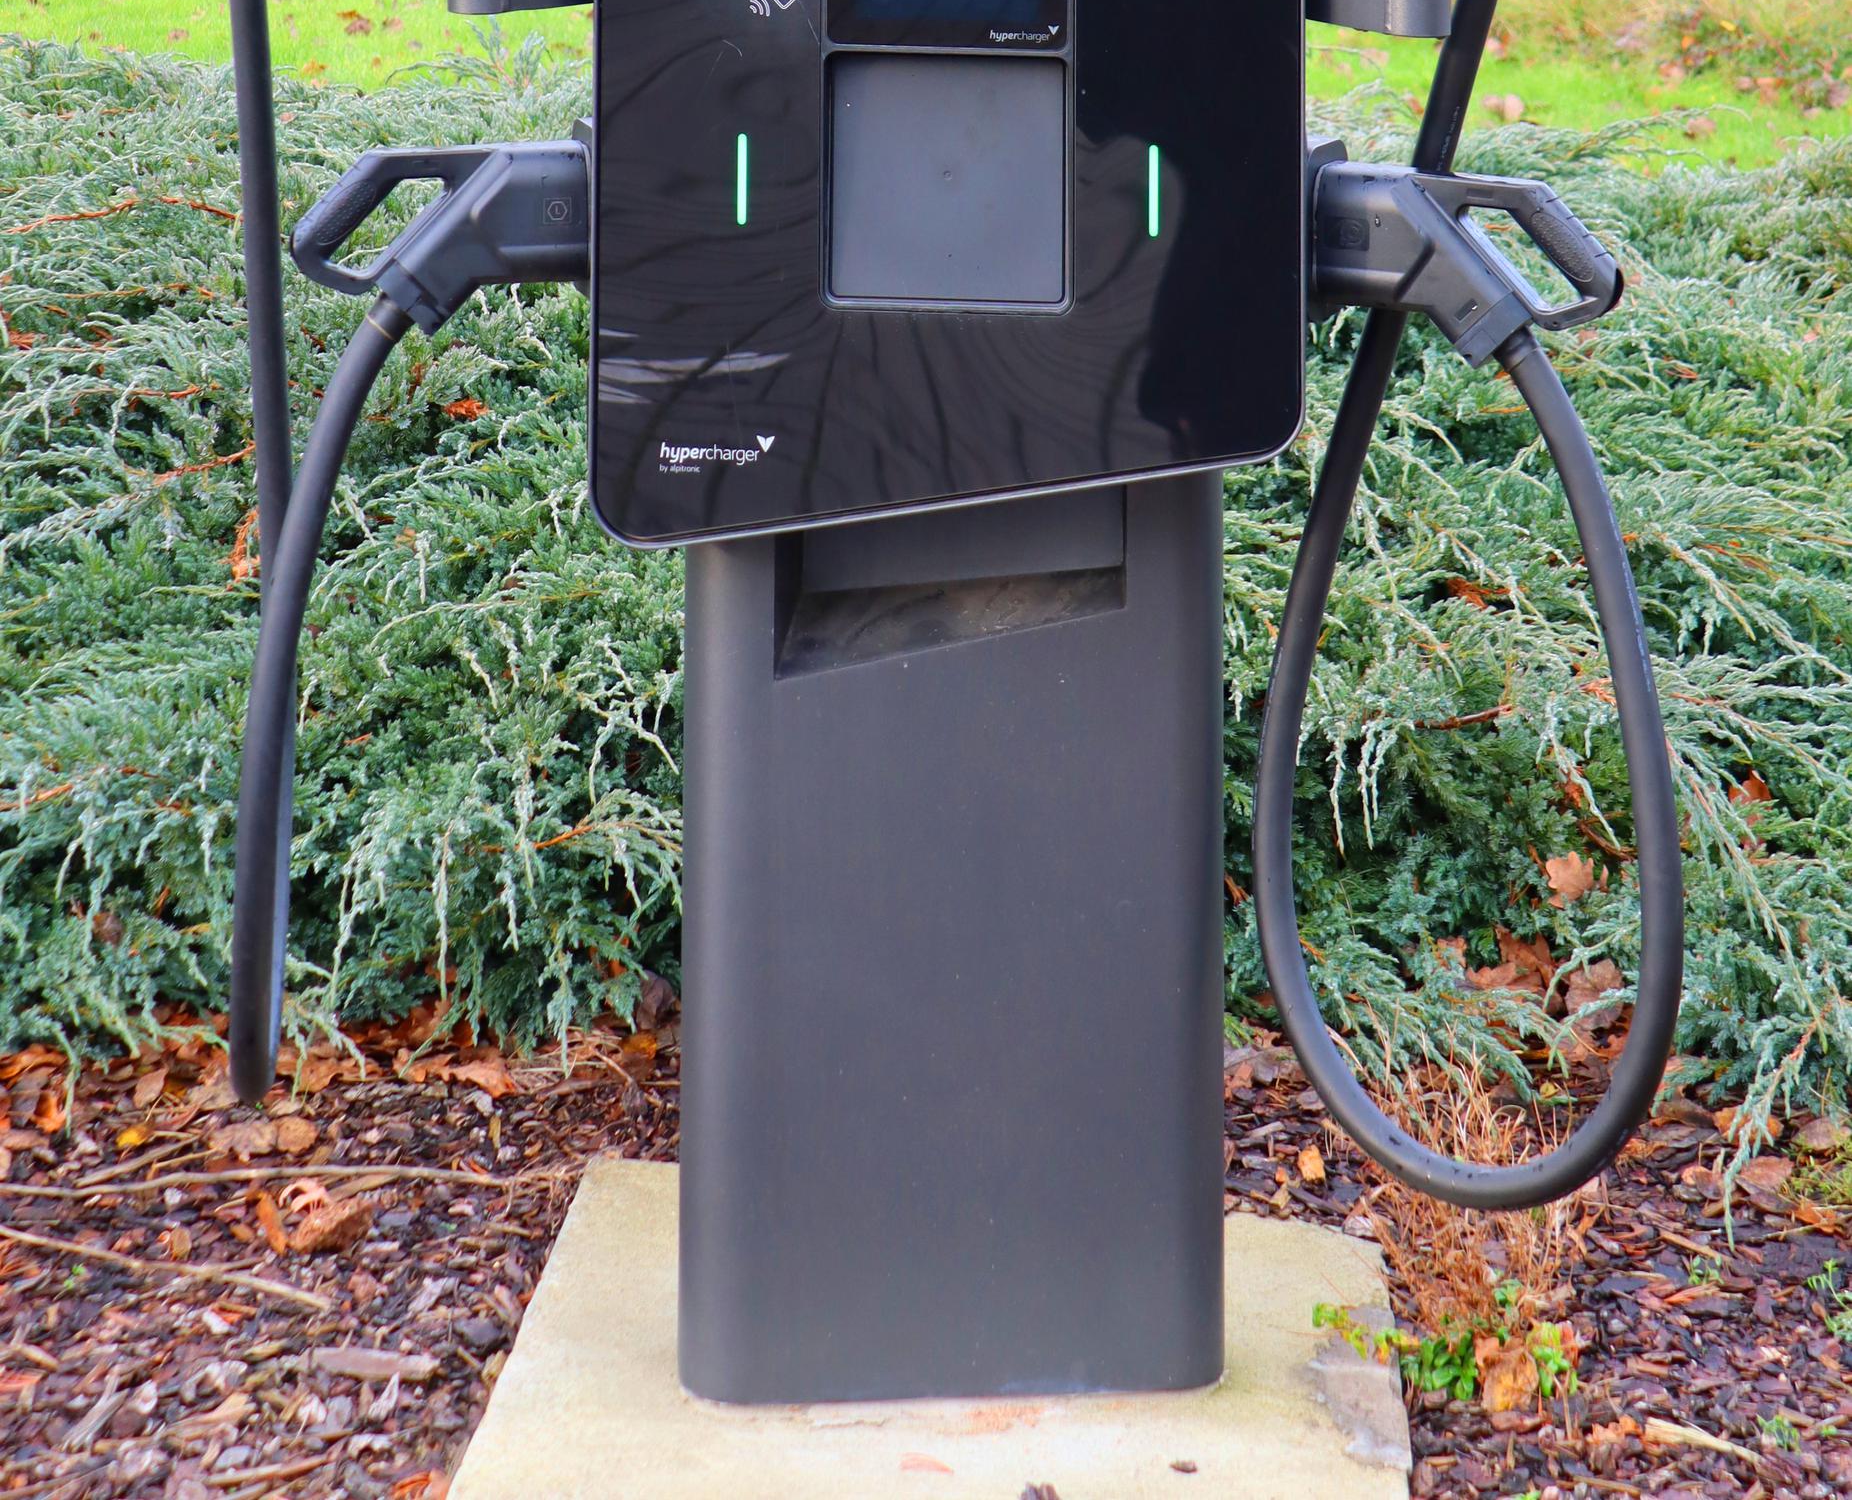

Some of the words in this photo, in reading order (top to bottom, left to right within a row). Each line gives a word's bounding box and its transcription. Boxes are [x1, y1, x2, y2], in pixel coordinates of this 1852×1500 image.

[989, 29, 1050, 44] hypercharger
[660, 441, 759, 466] hypercharger
[659, 463, 668, 474] by
